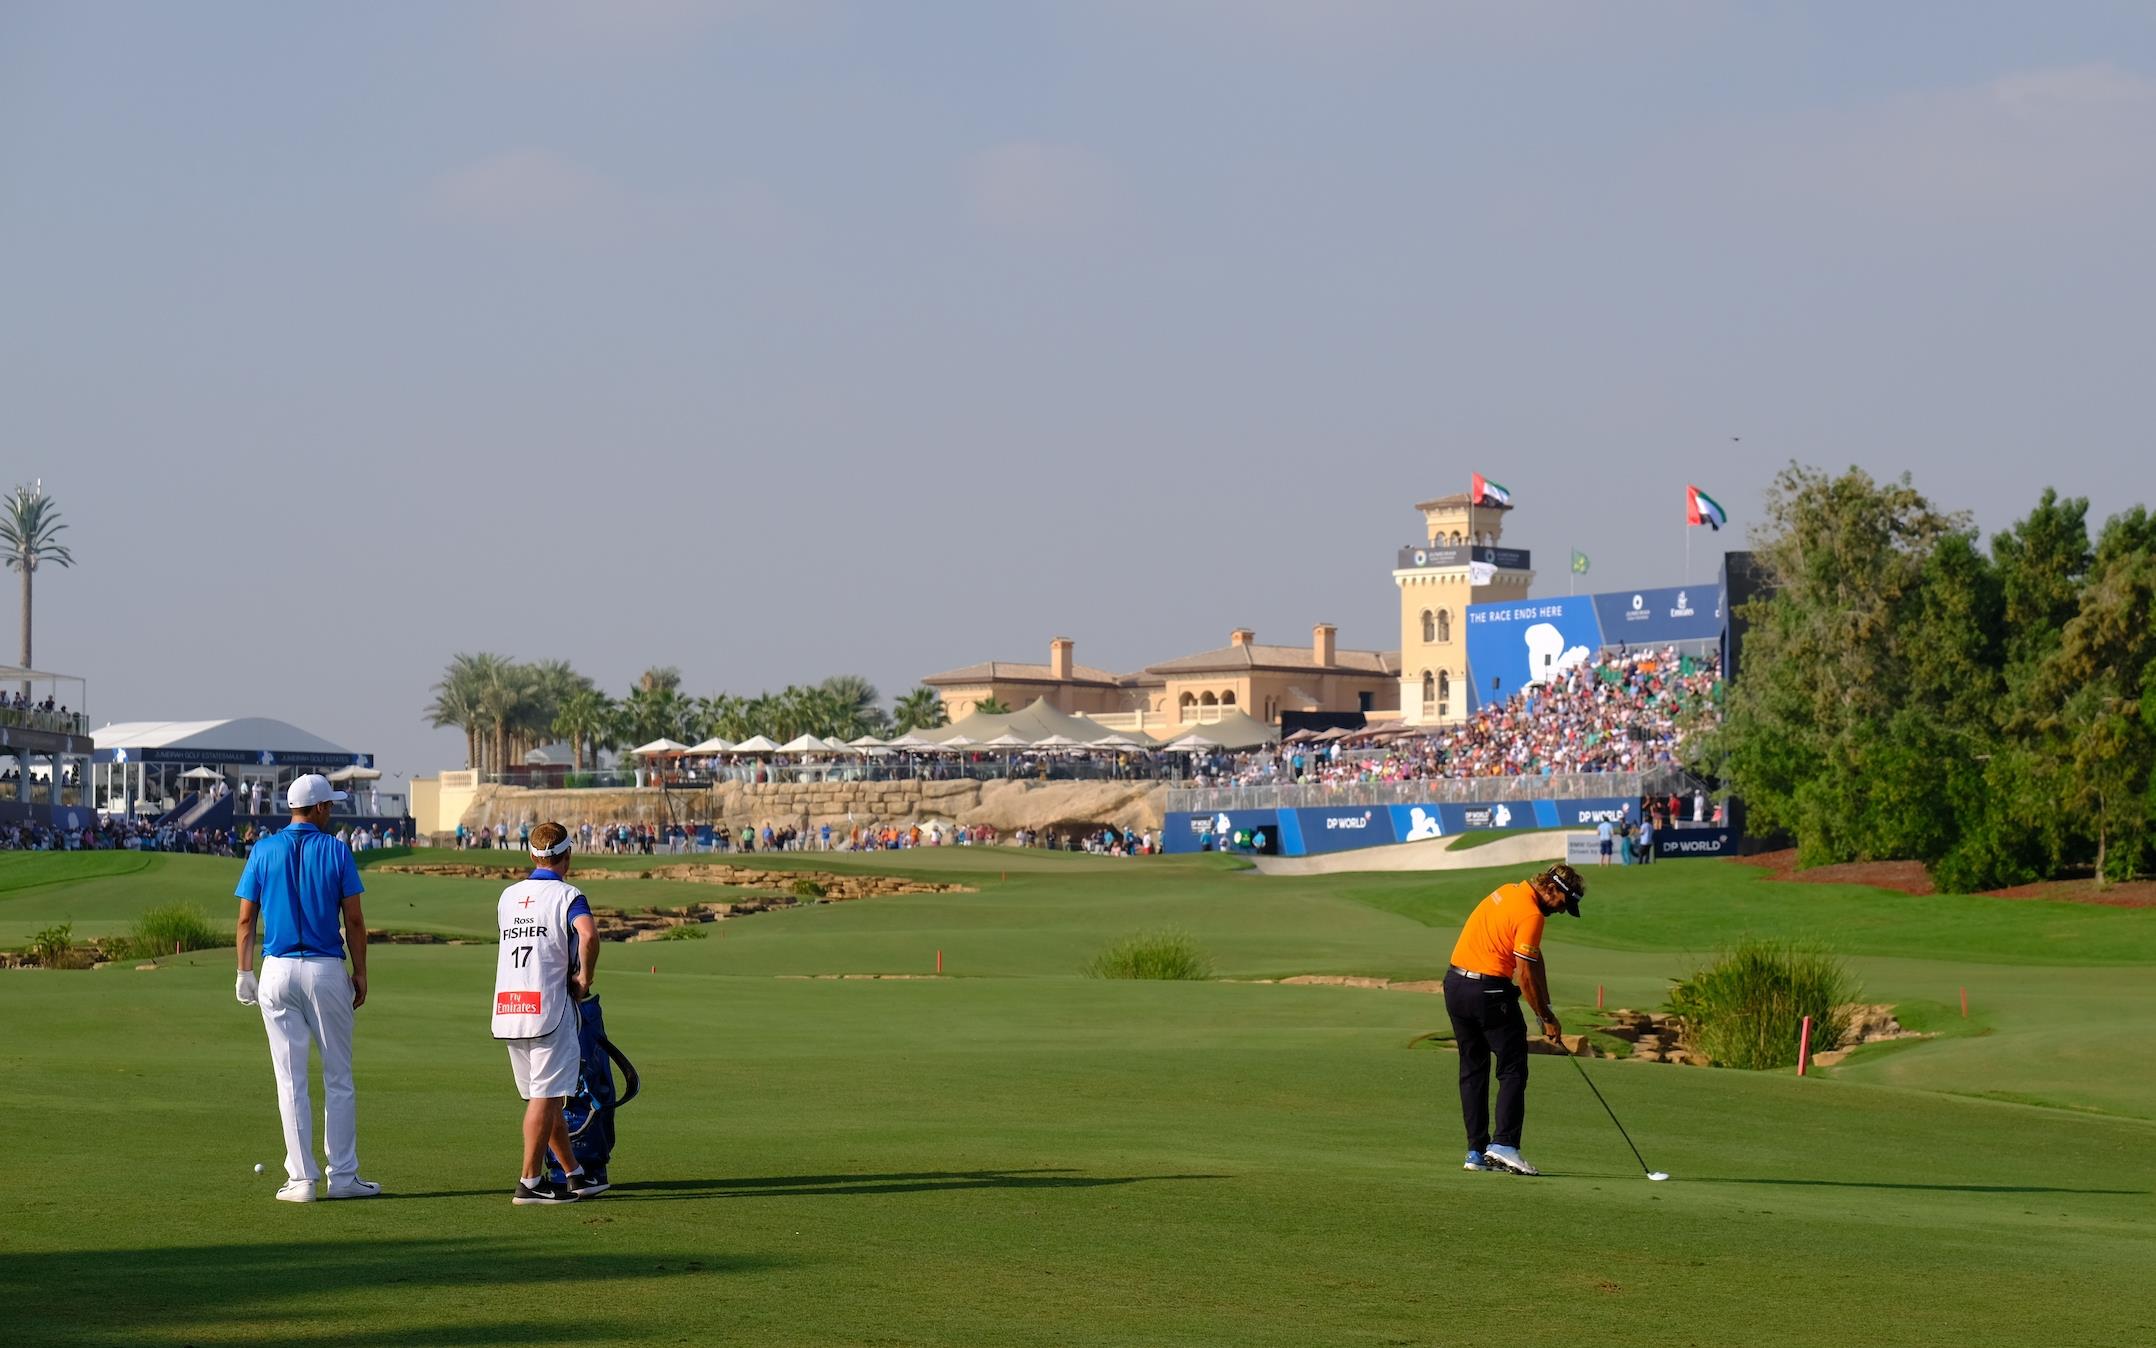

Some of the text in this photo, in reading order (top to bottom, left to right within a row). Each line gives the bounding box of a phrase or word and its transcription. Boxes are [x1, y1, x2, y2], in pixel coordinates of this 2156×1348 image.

[1470, 606, 1562, 623] THE RACE ENDS HERE
[1579, 810, 1624, 822] DP WORLD
[1327, 817, 1367, 829] DP WORLD
[1663, 840, 1721, 852] DP WORLD
[514, 917, 534, 925] Ross
[503, 926, 548, 941] FISHER
[511, 946, 533, 969] 17
[510, 993, 521, 1002] Fly
[497, 1003, 537, 1014] Emirates
